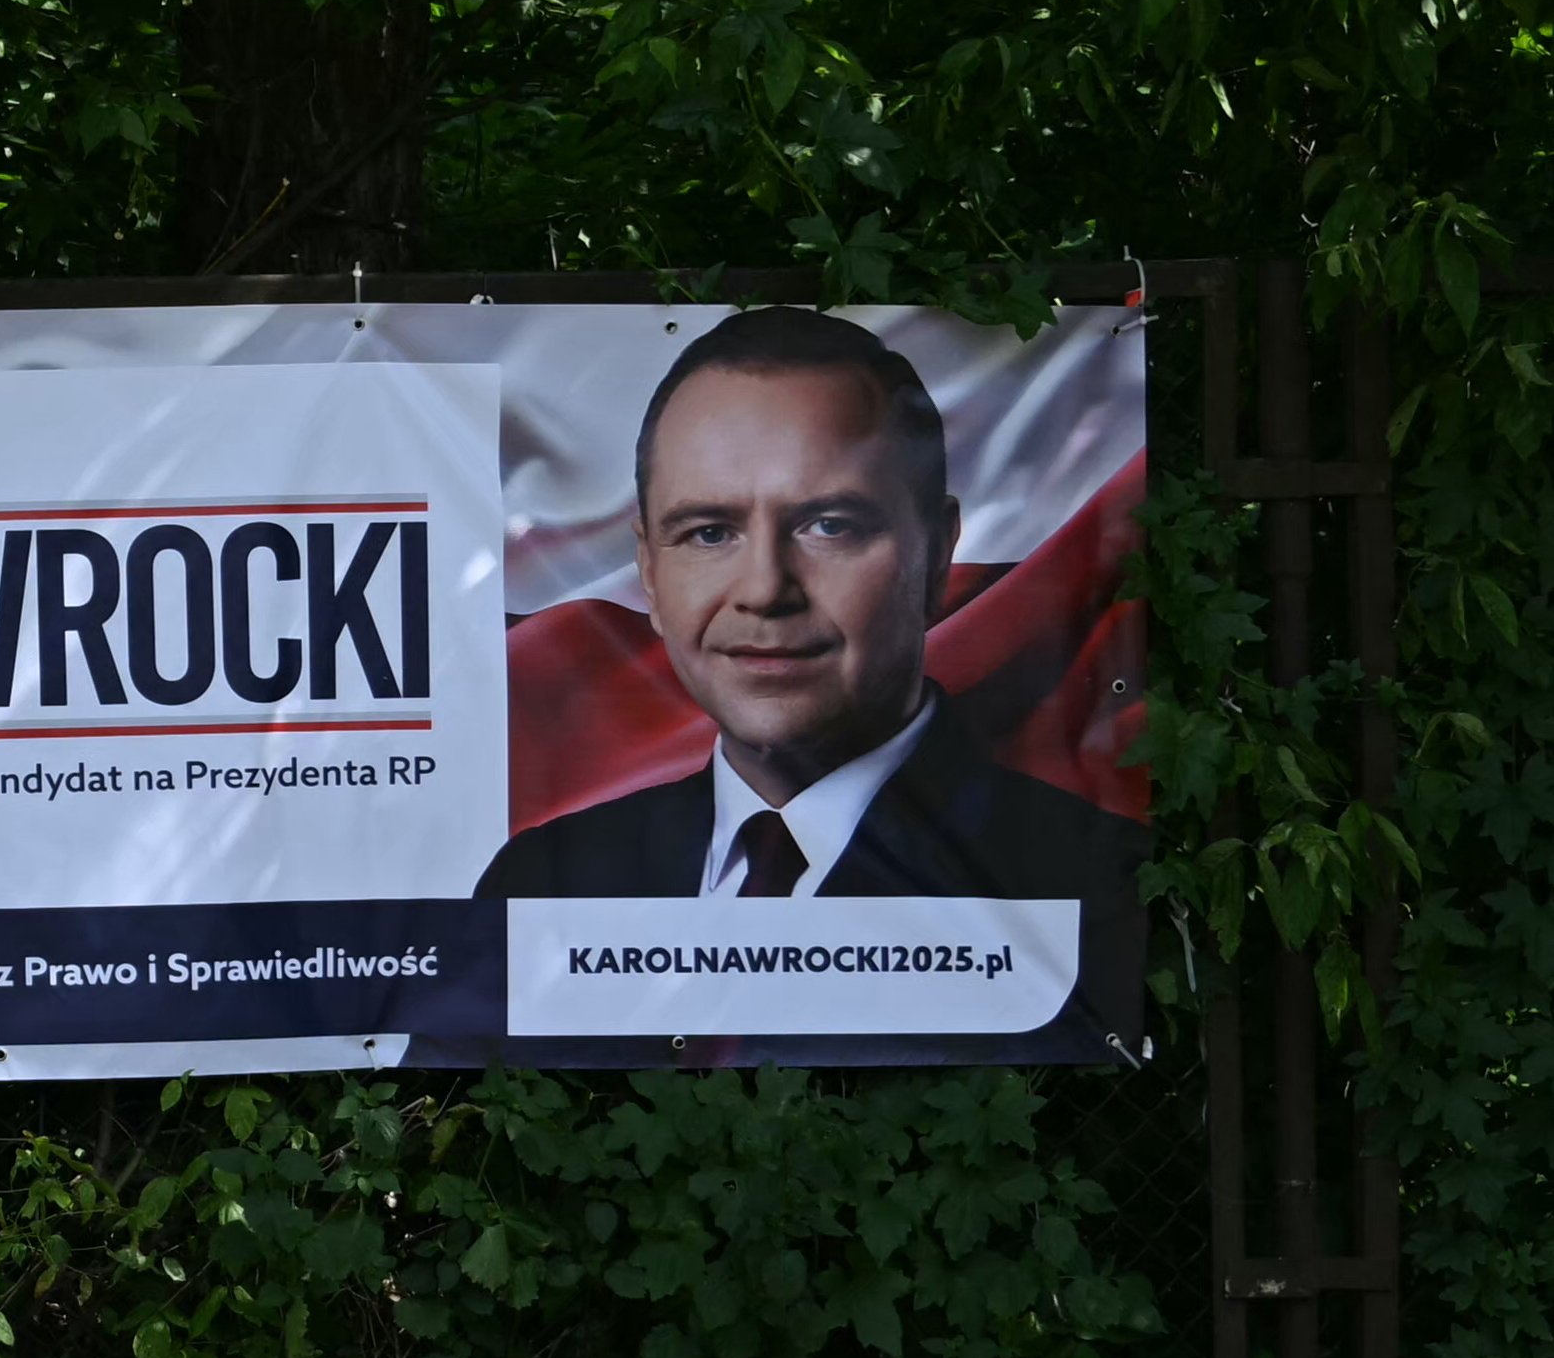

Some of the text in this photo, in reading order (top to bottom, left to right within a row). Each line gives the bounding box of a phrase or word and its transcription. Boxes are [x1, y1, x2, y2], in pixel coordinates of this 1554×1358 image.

[133, 769, 176, 791] na
[186, 756, 378, 796] Prezydenta
[389, 756, 436, 785] RP
[25, 956, 138, 986] Prawo
[148, 953, 157, 984] i
[167, 946, 438, 991] Sprawiedliwość
[569, 945, 1013, 980] KAROLNAWROCKI2025.pl
